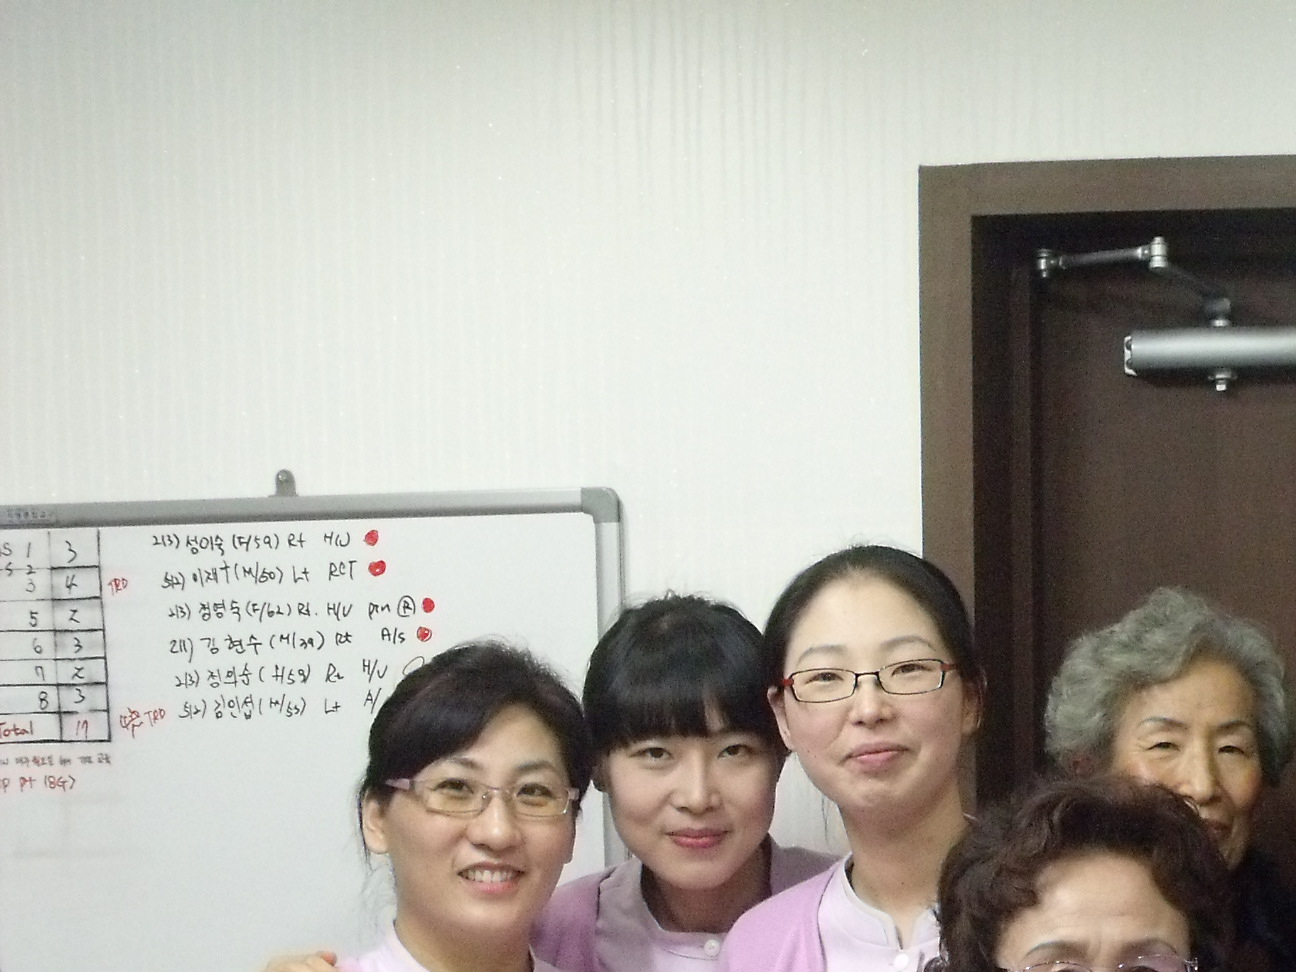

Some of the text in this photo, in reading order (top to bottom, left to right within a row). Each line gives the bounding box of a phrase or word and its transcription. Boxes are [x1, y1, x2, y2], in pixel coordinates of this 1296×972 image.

[65, 540, 77, 563] 3
[29, 610, 38, 627] 5
[33, 637, 83, 654] 6 3
[38, 688, 86, 710] 8 3
